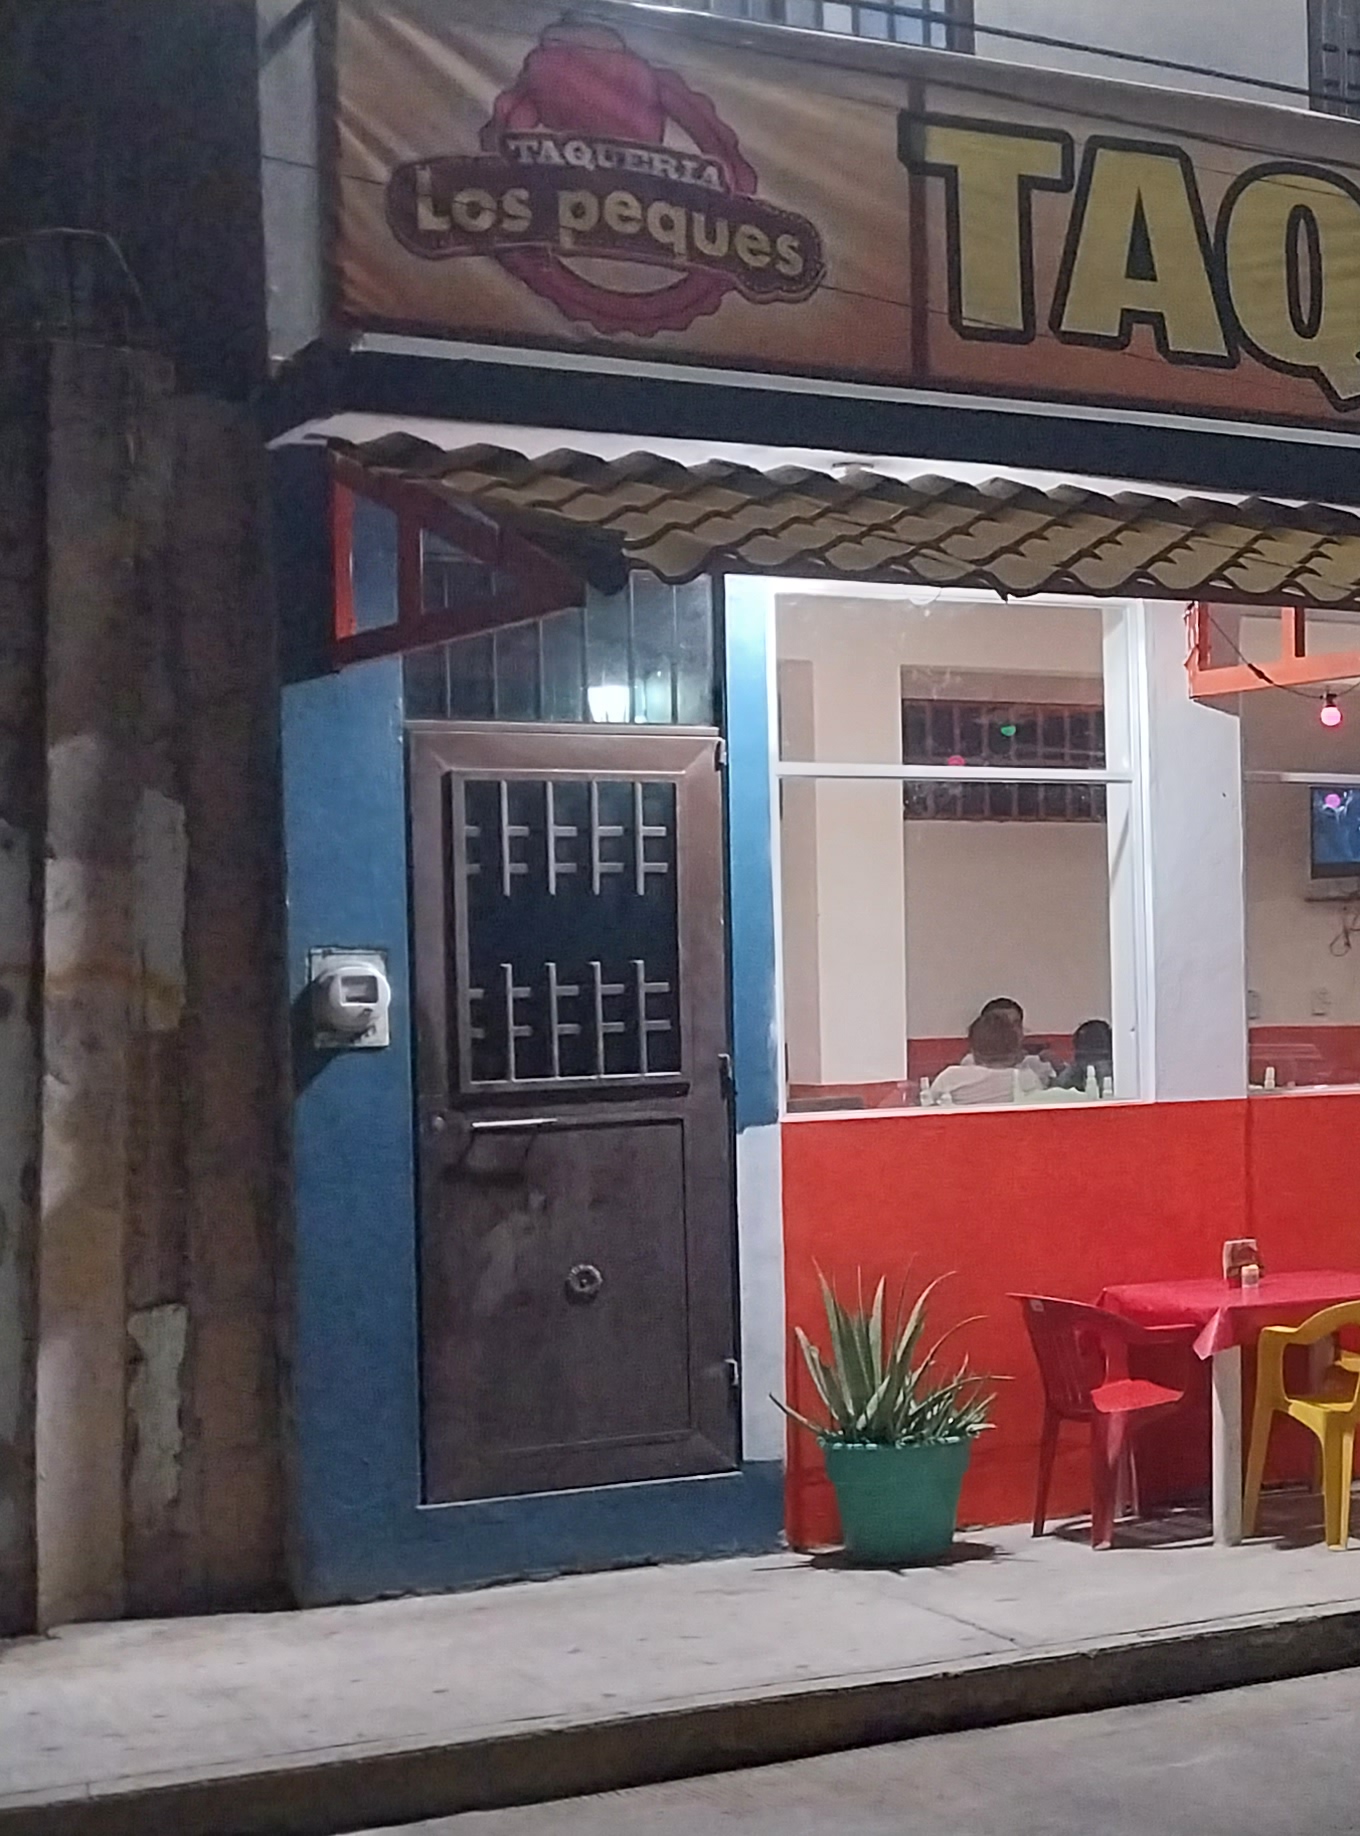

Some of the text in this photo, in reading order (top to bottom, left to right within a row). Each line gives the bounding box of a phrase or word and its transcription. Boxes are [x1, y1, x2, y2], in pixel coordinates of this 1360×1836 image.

[506, 138, 724, 191] TAQUERIA
[414, 165, 805, 278] Los peques
